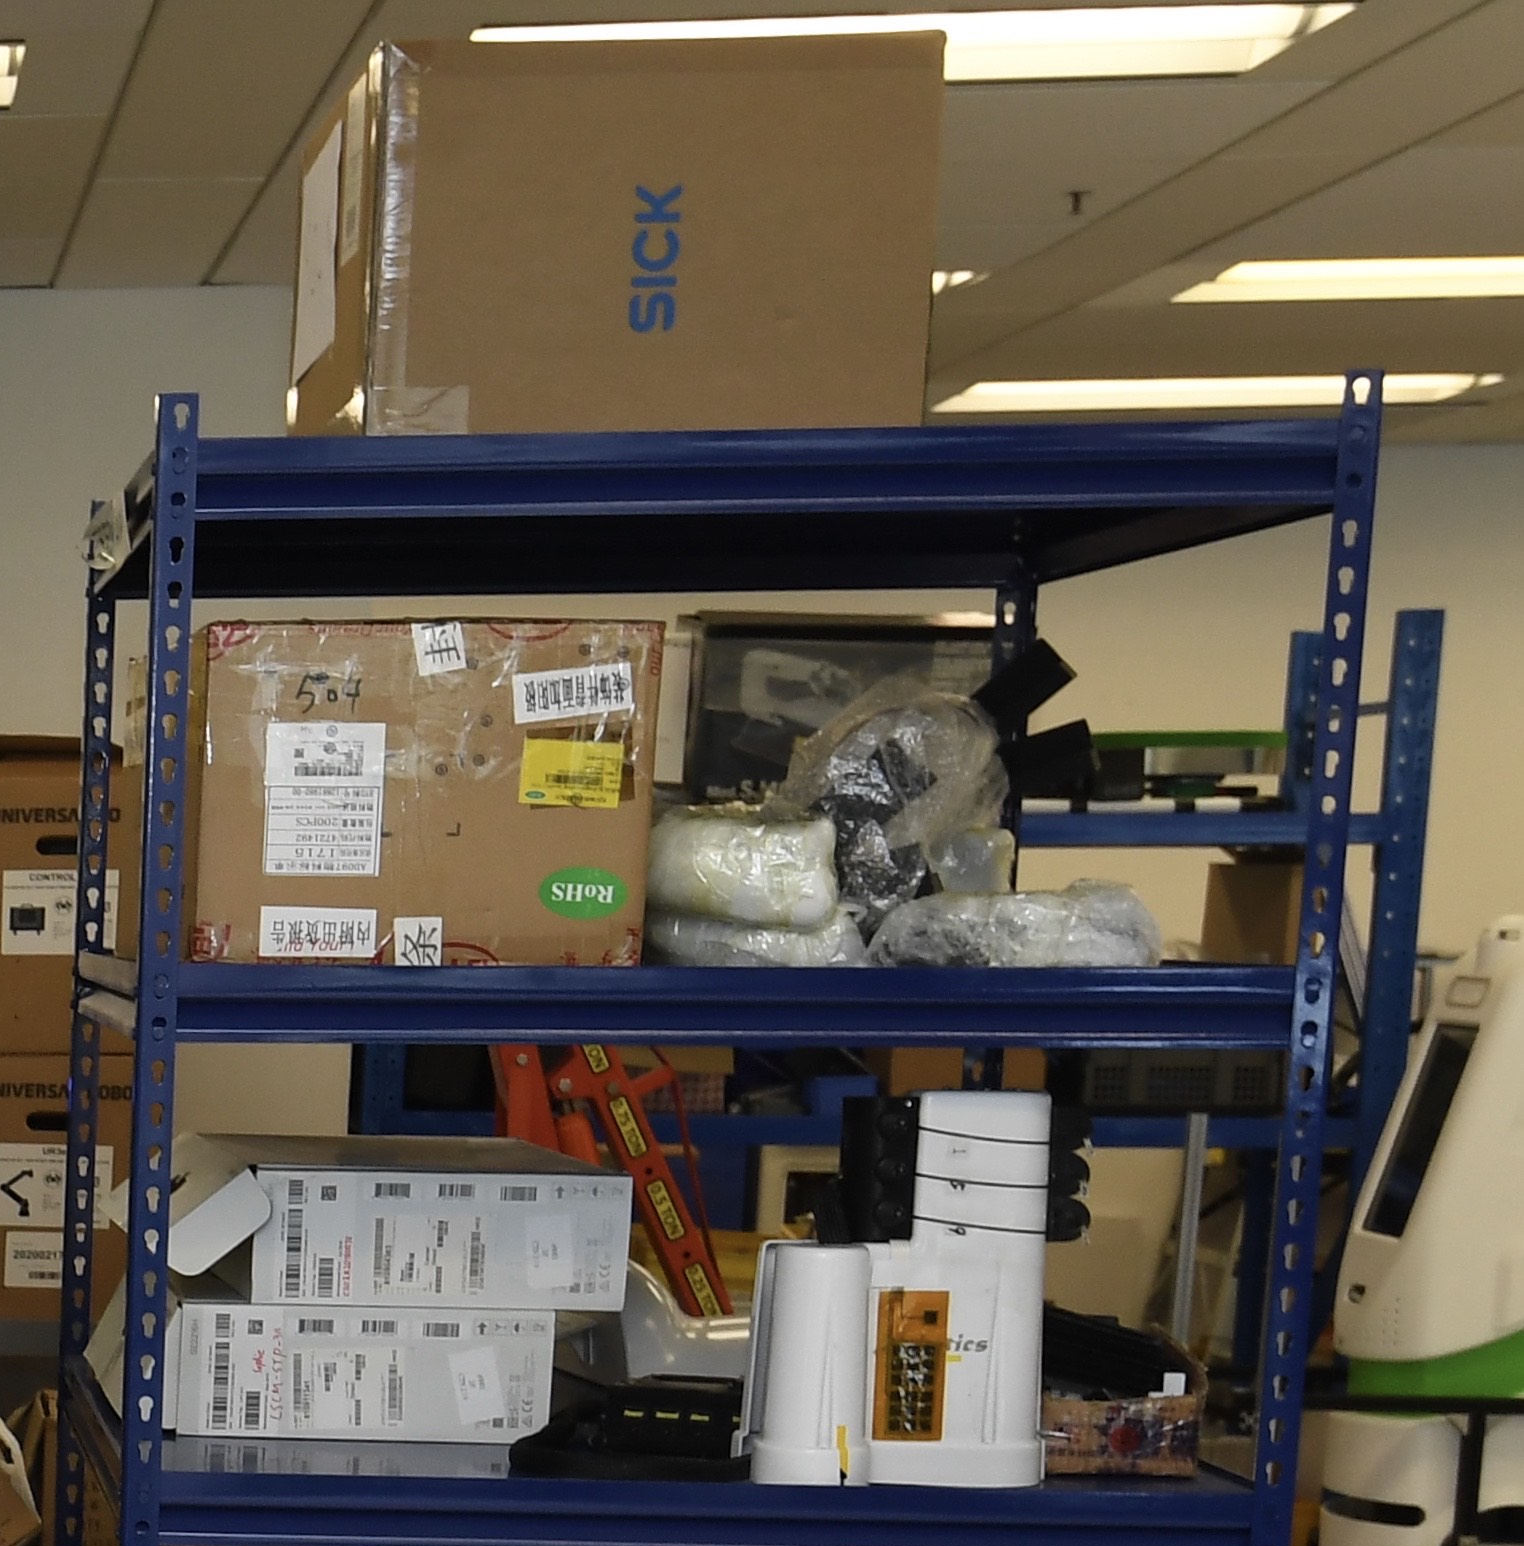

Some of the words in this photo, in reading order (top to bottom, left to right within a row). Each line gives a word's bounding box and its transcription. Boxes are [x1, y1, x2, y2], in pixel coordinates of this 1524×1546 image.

[628, 182, 684, 335] SICK
[295, 817, 339, 828] 200PCS
[295, 847, 335, 858] 1715
[550, 881, 615, 904] RoHS
[625, 1127, 646, 1156] TON
[660, 1206, 681, 1236] TON
